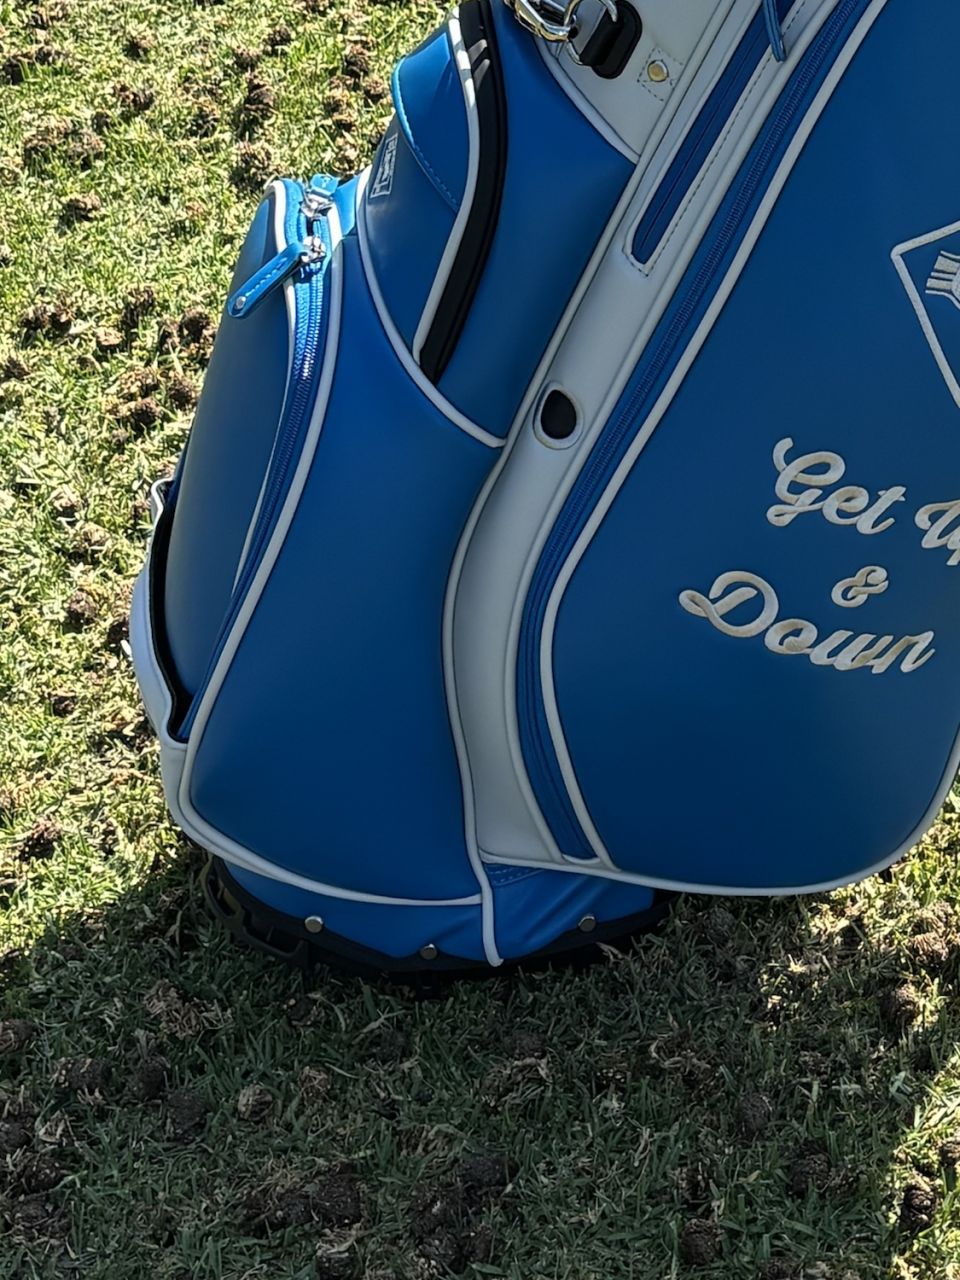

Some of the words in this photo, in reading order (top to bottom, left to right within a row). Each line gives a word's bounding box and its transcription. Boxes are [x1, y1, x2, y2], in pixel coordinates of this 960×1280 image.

[766, 437, 906, 535] Get
[678, 570, 935, 674] Down
[831, 565, 889, 608] &
